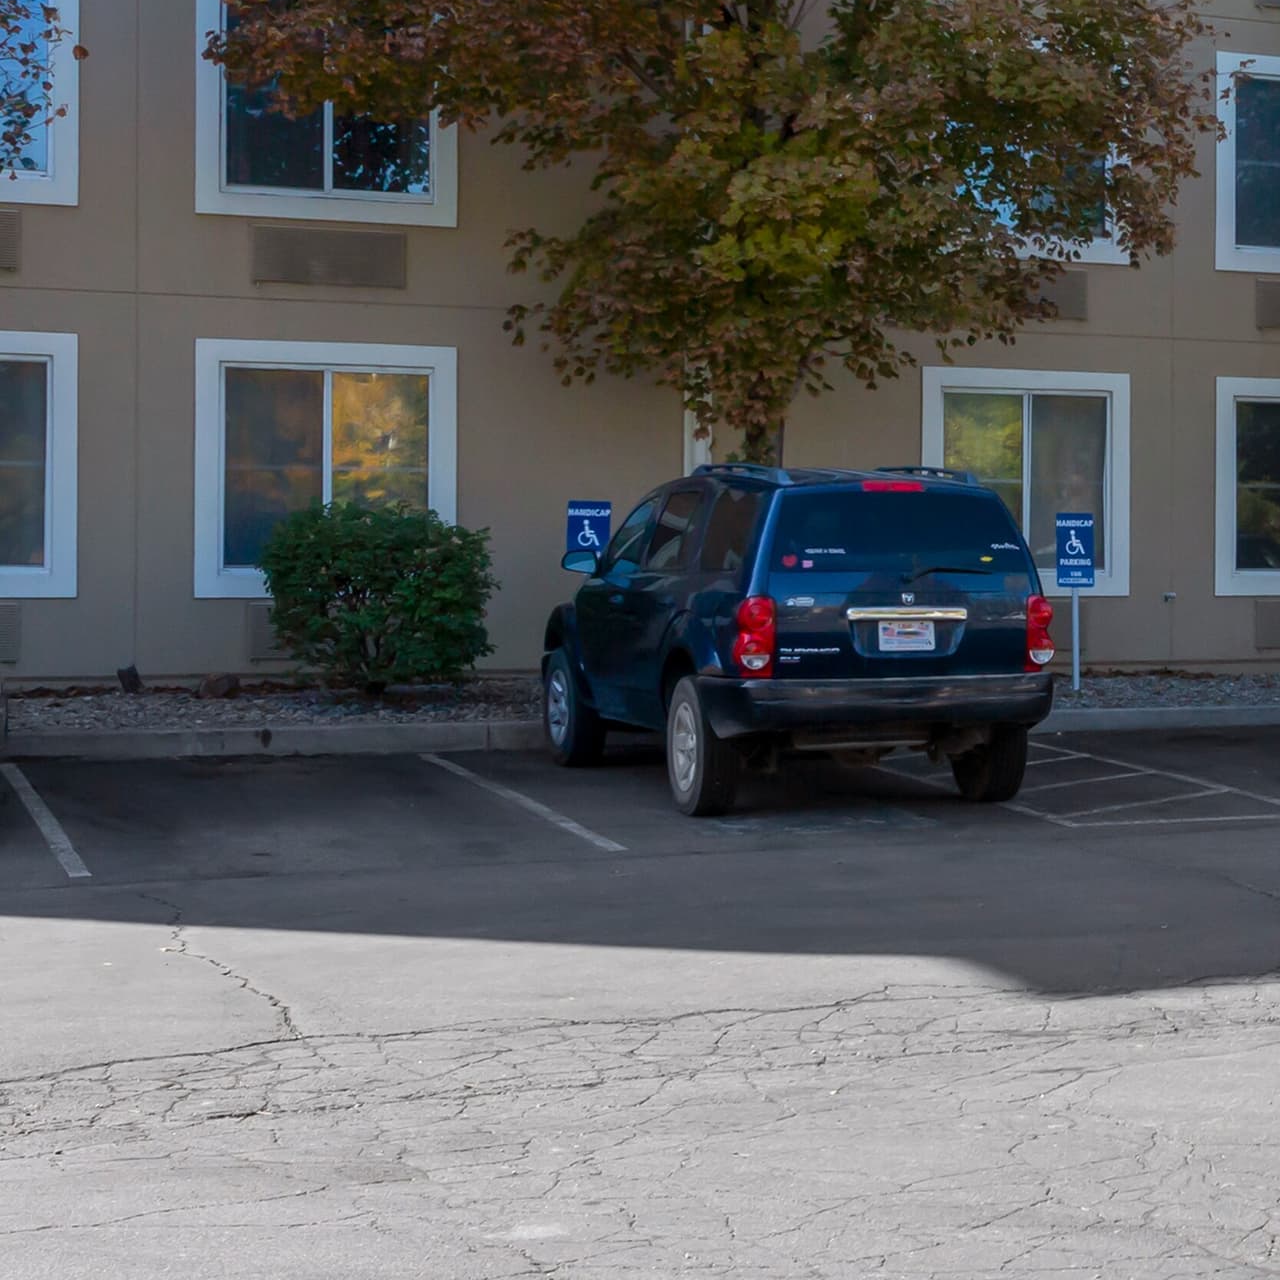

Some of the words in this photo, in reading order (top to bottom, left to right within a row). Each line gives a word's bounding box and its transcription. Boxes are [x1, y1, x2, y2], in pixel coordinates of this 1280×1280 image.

[568, 508, 611, 517] HANDICAP
[1056, 519, 1094, 527] HANDICAP
[1060, 558, 1092, 566] PARKING
